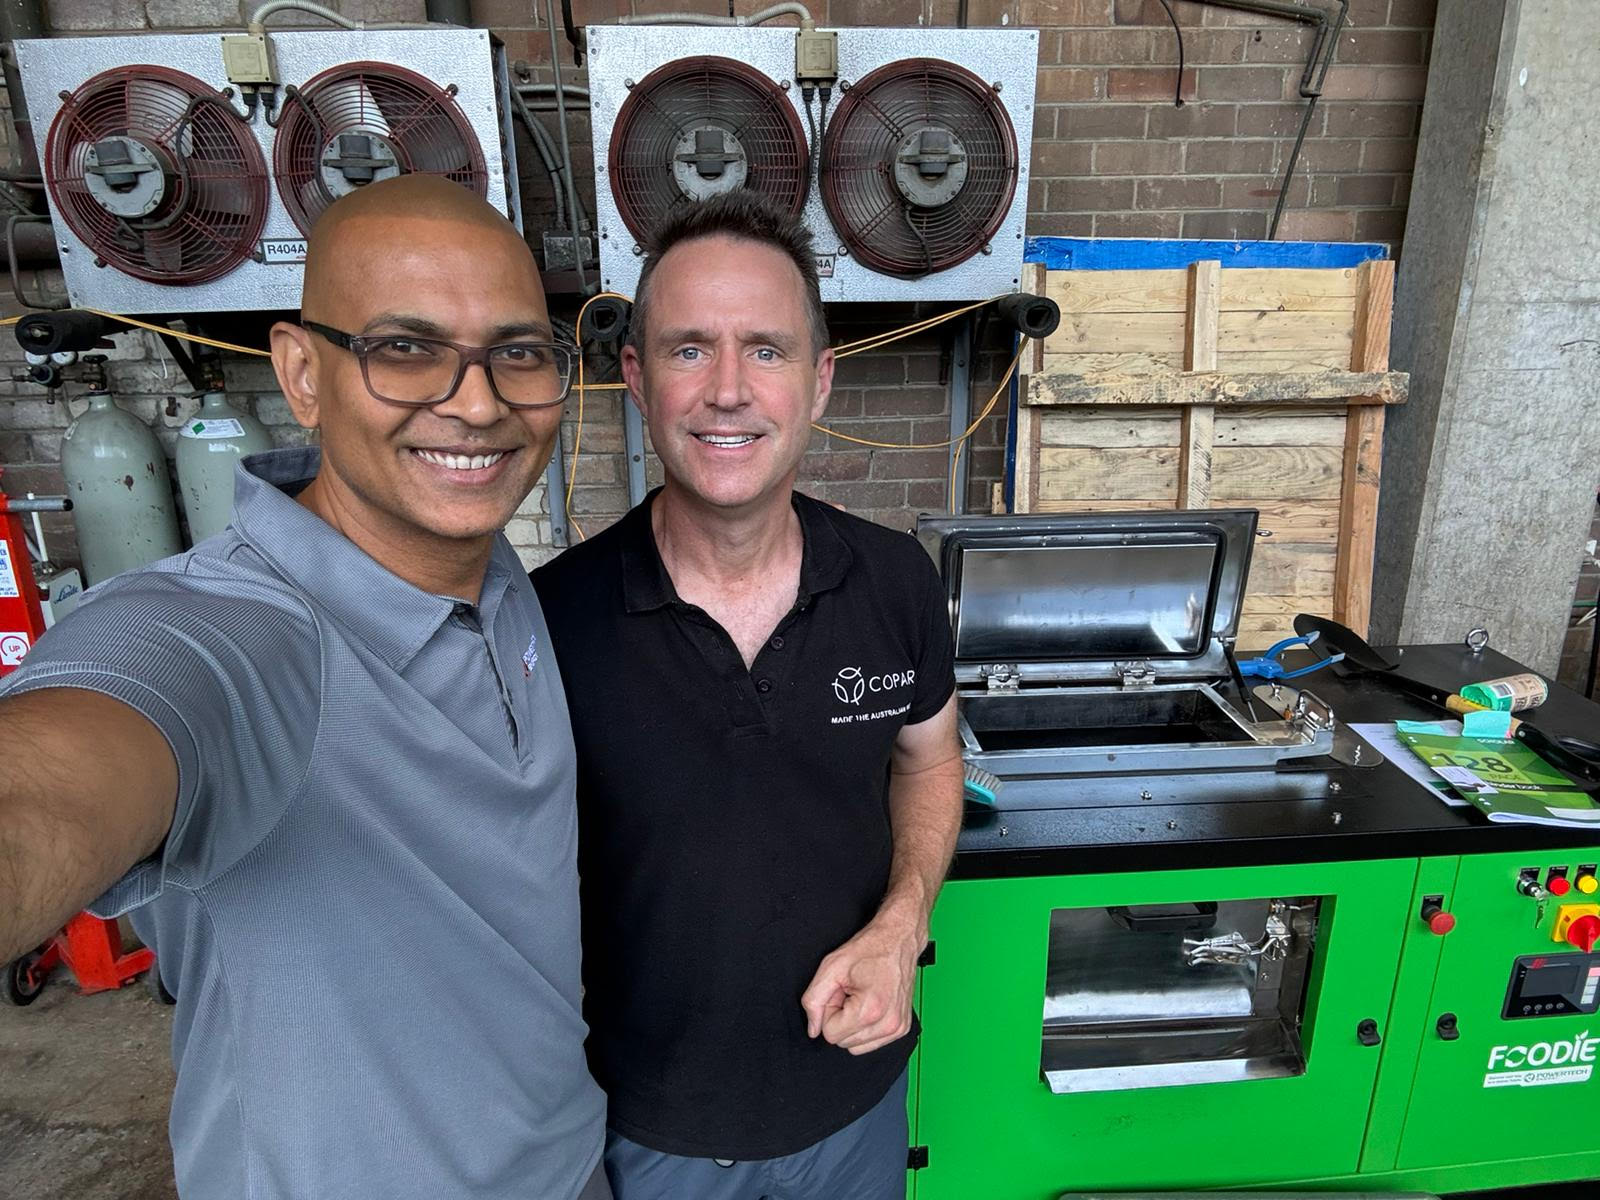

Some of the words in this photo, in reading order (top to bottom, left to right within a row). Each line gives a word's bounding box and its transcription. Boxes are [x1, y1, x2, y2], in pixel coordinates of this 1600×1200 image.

[267, 244, 306, 254] R404A
[815, 259, 832, 269] 4A
[9, 645, 20, 653] UP
[869, 669, 915, 693] COPAR
[831, 715, 854, 725] MADE
[855, 712, 870, 722] THE
[1433, 752, 1513, 774] 128
